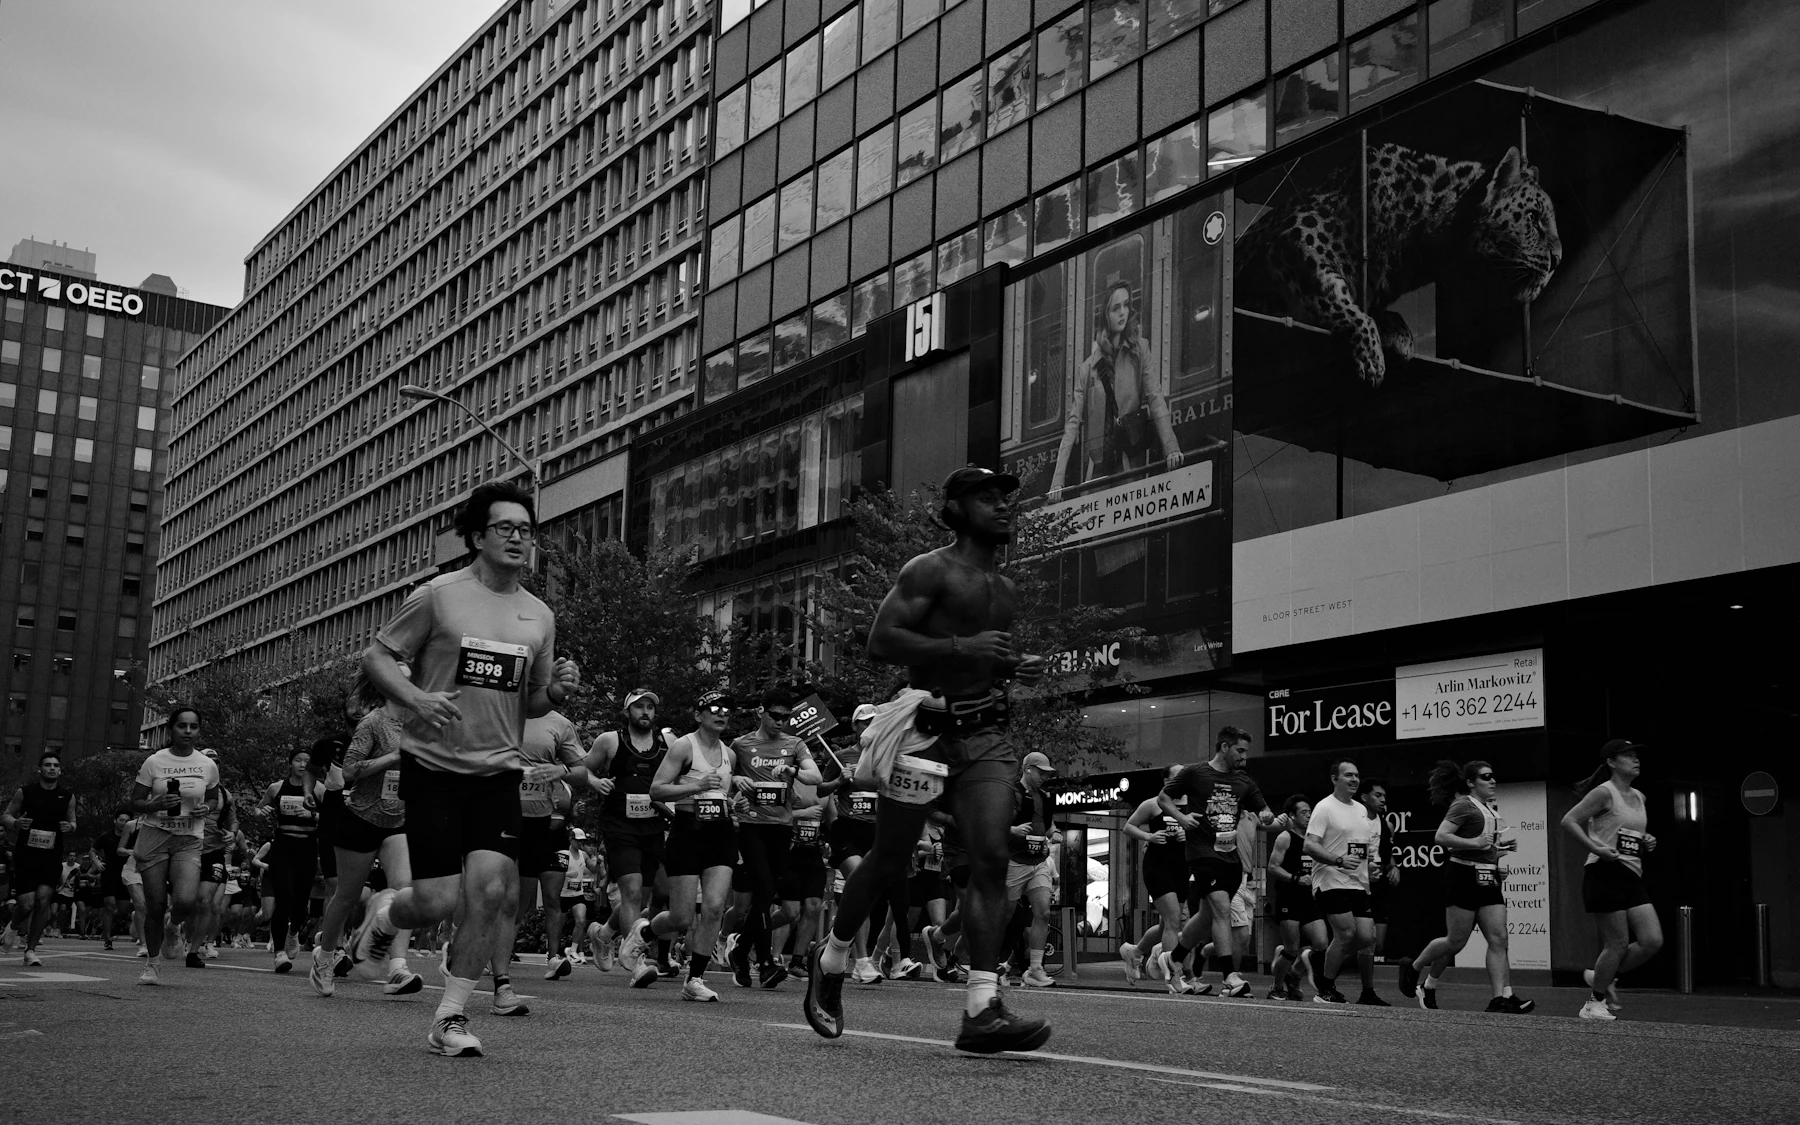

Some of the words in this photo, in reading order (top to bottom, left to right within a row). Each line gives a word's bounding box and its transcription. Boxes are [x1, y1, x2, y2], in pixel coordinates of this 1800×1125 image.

[0, 268, 33, 294] CT
[66, 283, 144, 316] OEEO
[905, 291, 946, 362] 151
[1105, 480, 1172, 508] MONTBLANC
[1086, 514, 1106, 531] OF
[1262, 611, 1291, 623] BLOOR
[1293, 603, 1326, 616] STREET
[1328, 600, 1353, 611] WEST
[1208, 641, 1223, 650] Write
[465, 660, 503, 677] 3898
[1513, 656, 1538, 668] Retail
[1269, 689, 1290, 699] CBRE
[1434, 680, 1465, 694] Arlin
[1401, 704, 1417, 721] +1
[1422, 700, 1451, 719] 416
[1456, 696, 1487, 716] 362
[1493, 691, 1537, 713] 2244
[790, 706, 818, 727] 4:00
[1269, 704, 1310, 736] For
[1312, 700, 1392, 731] Lease
[189, 766, 204, 774] TCS
[756, 792, 777, 800] 4580
[699, 805, 720, 814] 7300
[852, 802, 872, 810] 6338
[1520, 820, 1545, 831] Retail
[1518, 922, 1547, 935] 2244
